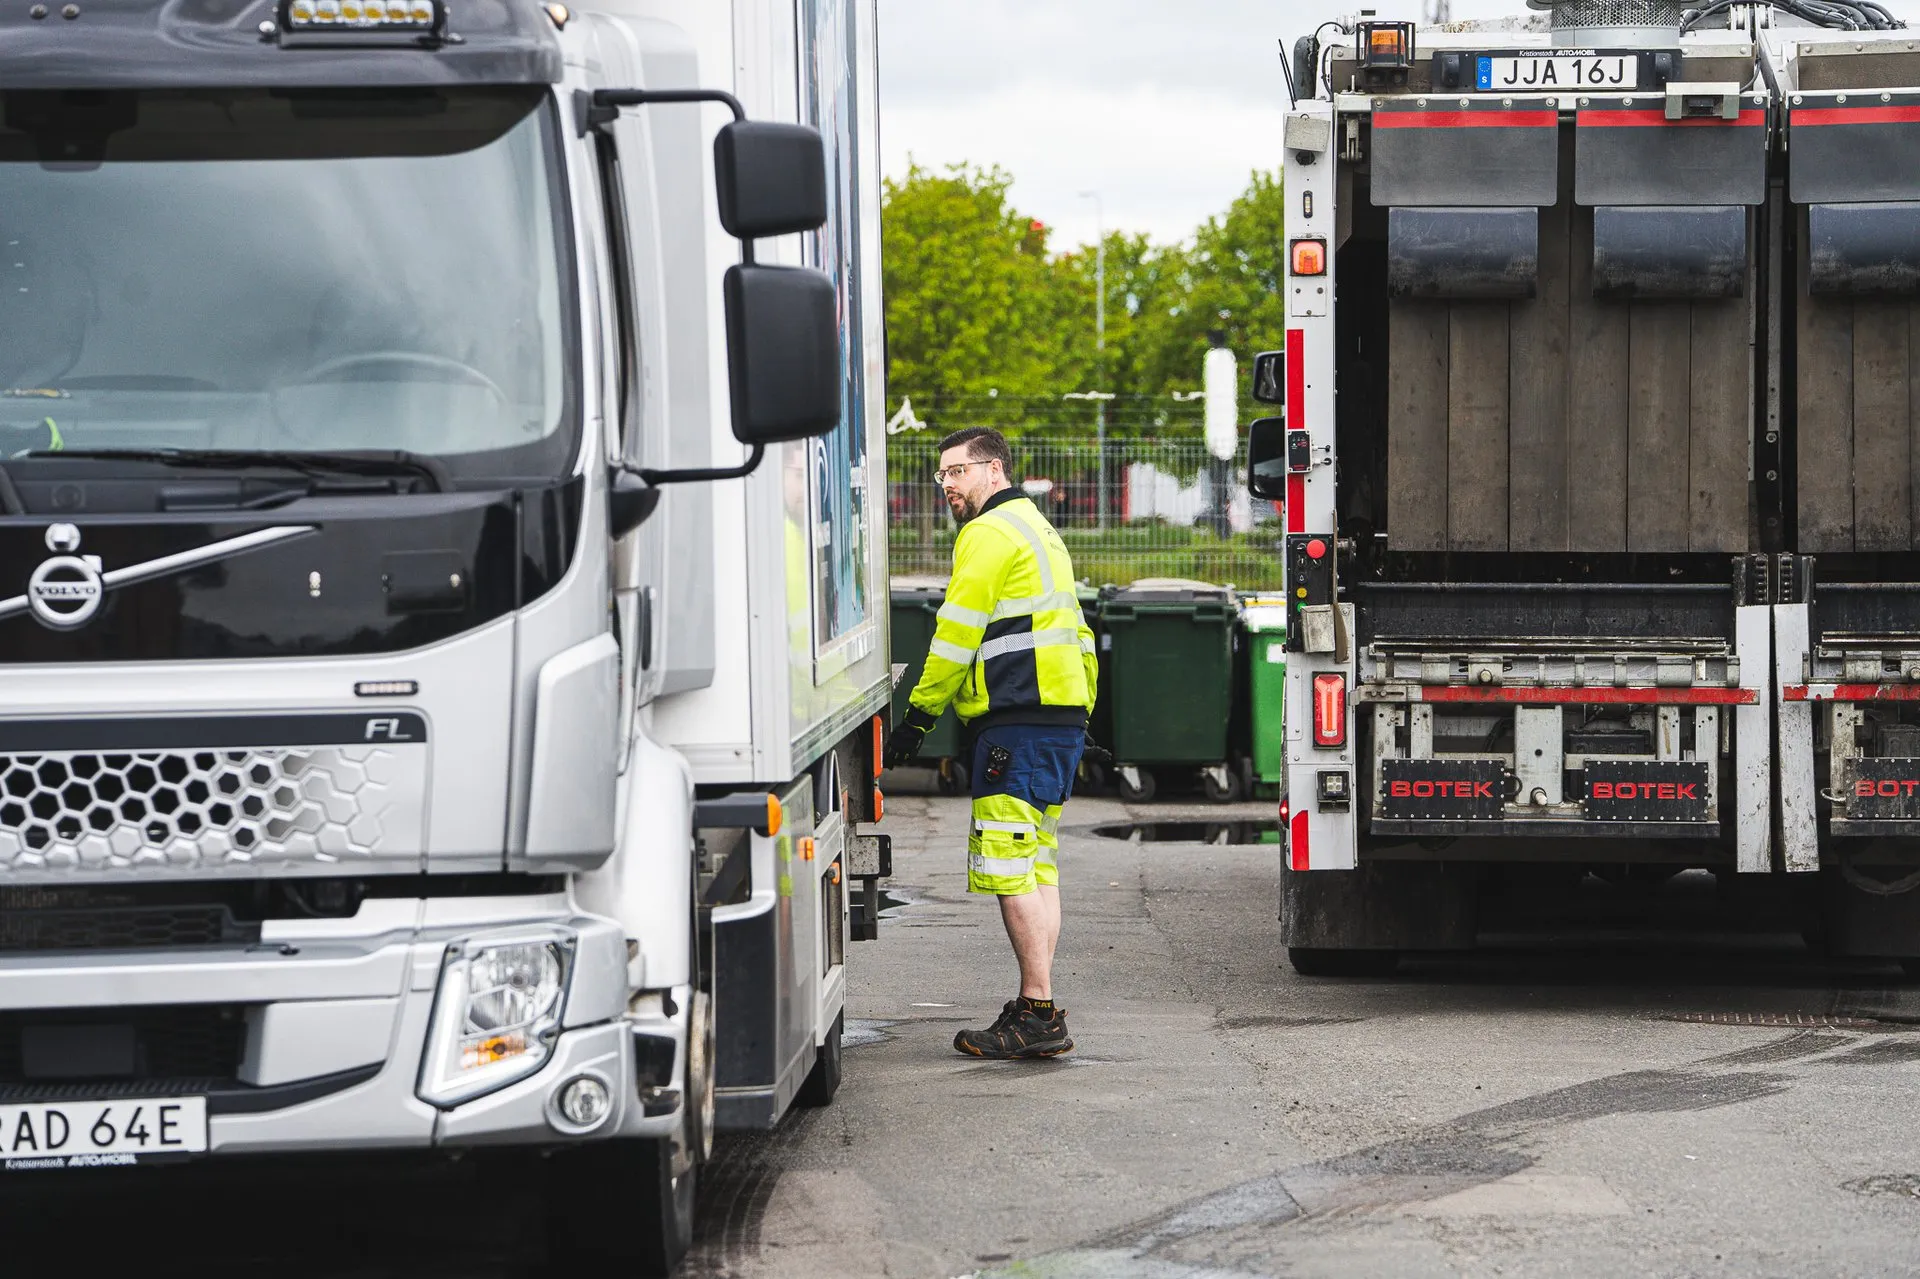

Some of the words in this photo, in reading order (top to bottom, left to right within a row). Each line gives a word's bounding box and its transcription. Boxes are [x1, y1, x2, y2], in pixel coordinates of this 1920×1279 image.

[1481, 76, 1488, 84] S
[1503, 59, 1558, 85] JJA
[1571, 59, 1624, 84] 16J
[34, 586, 97, 595] VOLVO
[364, 718, 413, 739] FL
[1391, 780, 1494, 798] BOTEK
[1593, 782, 1697, 800] BOTEK
[0, 1110, 70, 1151] AD
[90, 1105, 183, 1147] 64E
